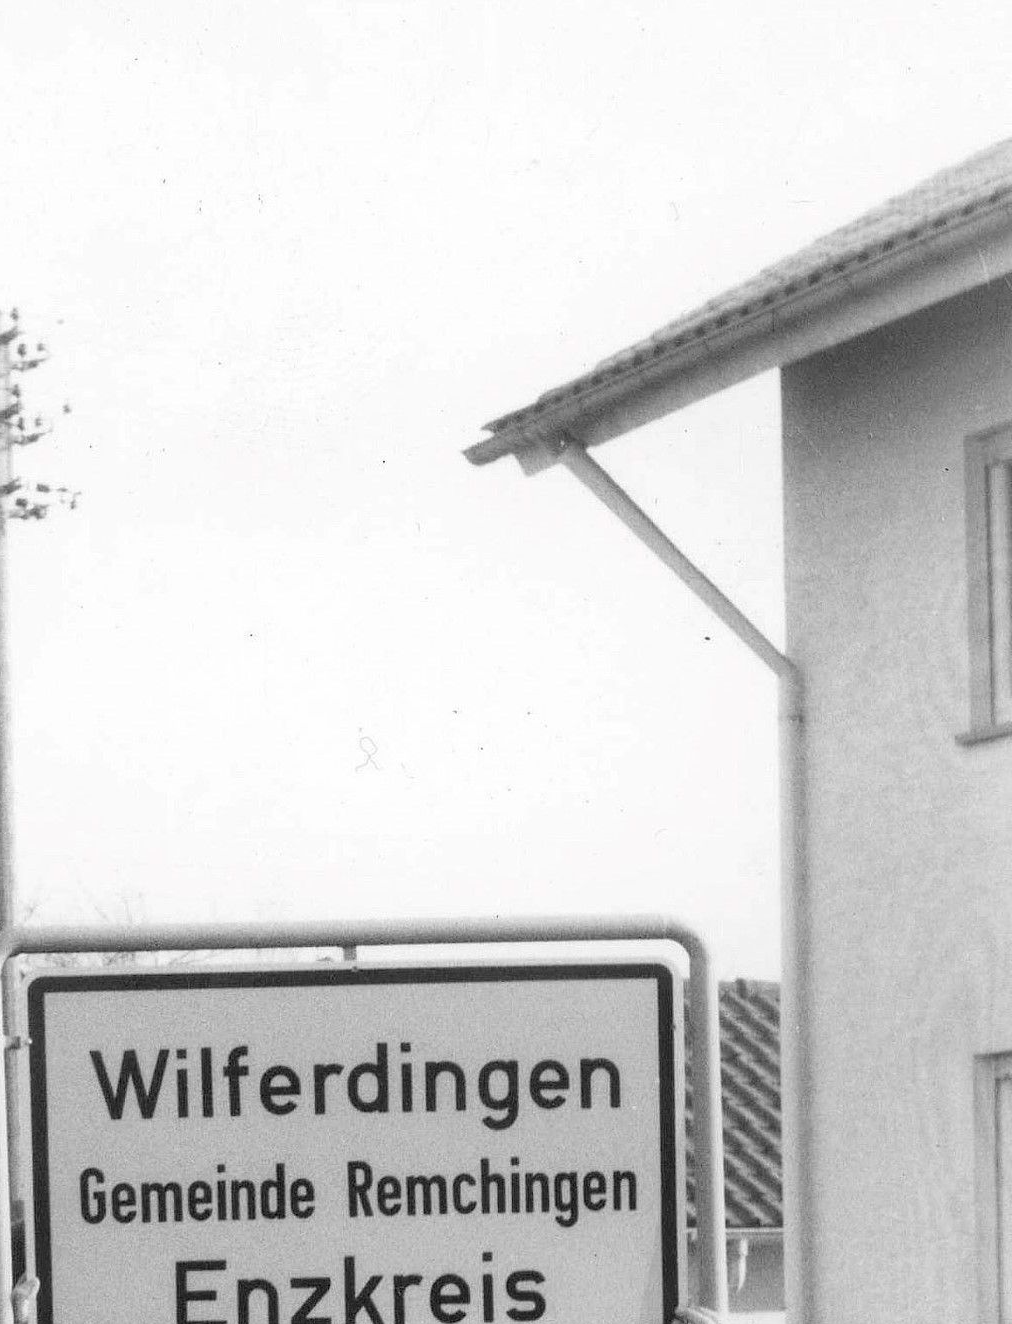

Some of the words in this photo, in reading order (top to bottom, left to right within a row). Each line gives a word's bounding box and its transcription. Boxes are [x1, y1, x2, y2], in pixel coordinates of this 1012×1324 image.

[89, 1042, 622, 1130] Wilferdingen
[79, 1163, 316, 1225] Gemeinde
[348, 1157, 638, 1227] Remchingen
